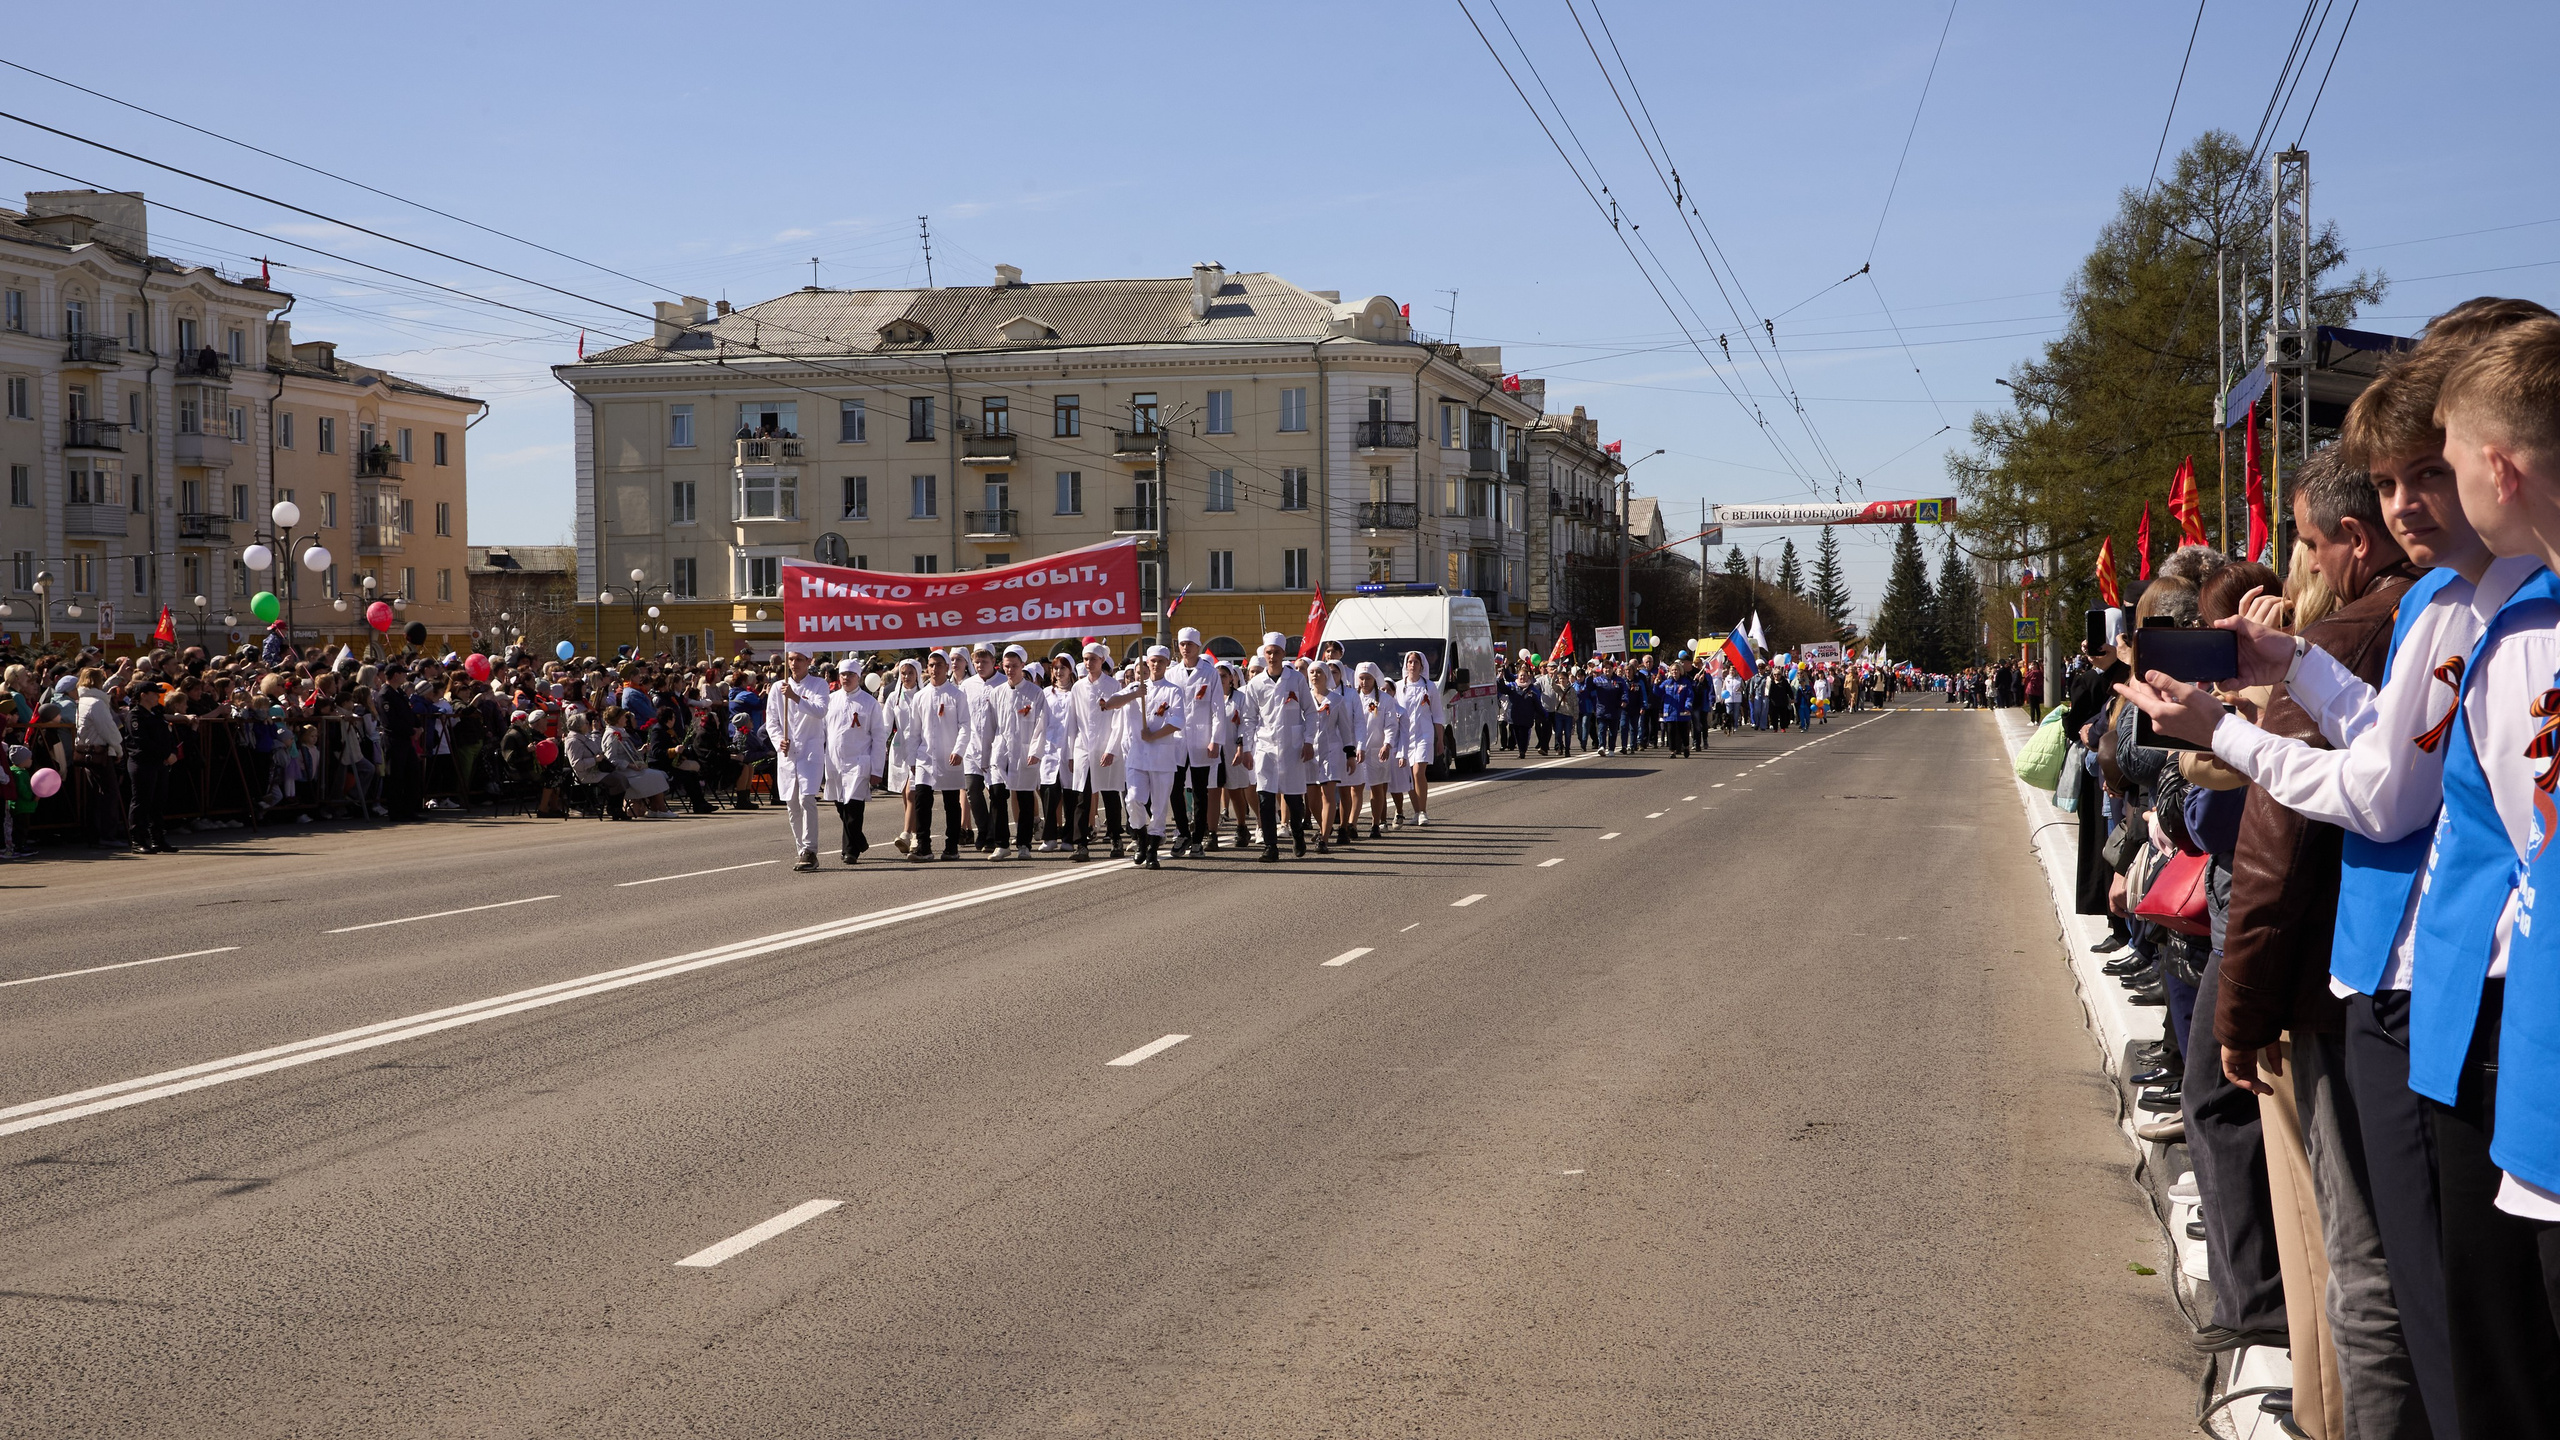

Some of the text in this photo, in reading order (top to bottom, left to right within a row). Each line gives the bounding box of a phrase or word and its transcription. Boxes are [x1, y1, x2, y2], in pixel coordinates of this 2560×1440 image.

[1721, 511, 1729, 521] С
[1732, 508, 1790, 521] ВЕЛИКОЙ
[1794, 506, 1859, 521] ПОБЕДОЙ!
[1876, 504, 1885, 519] 9
[801, 564, 1108, 599] Никто не забыт,
[799, 591, 1126, 633] ничто не забыто!
